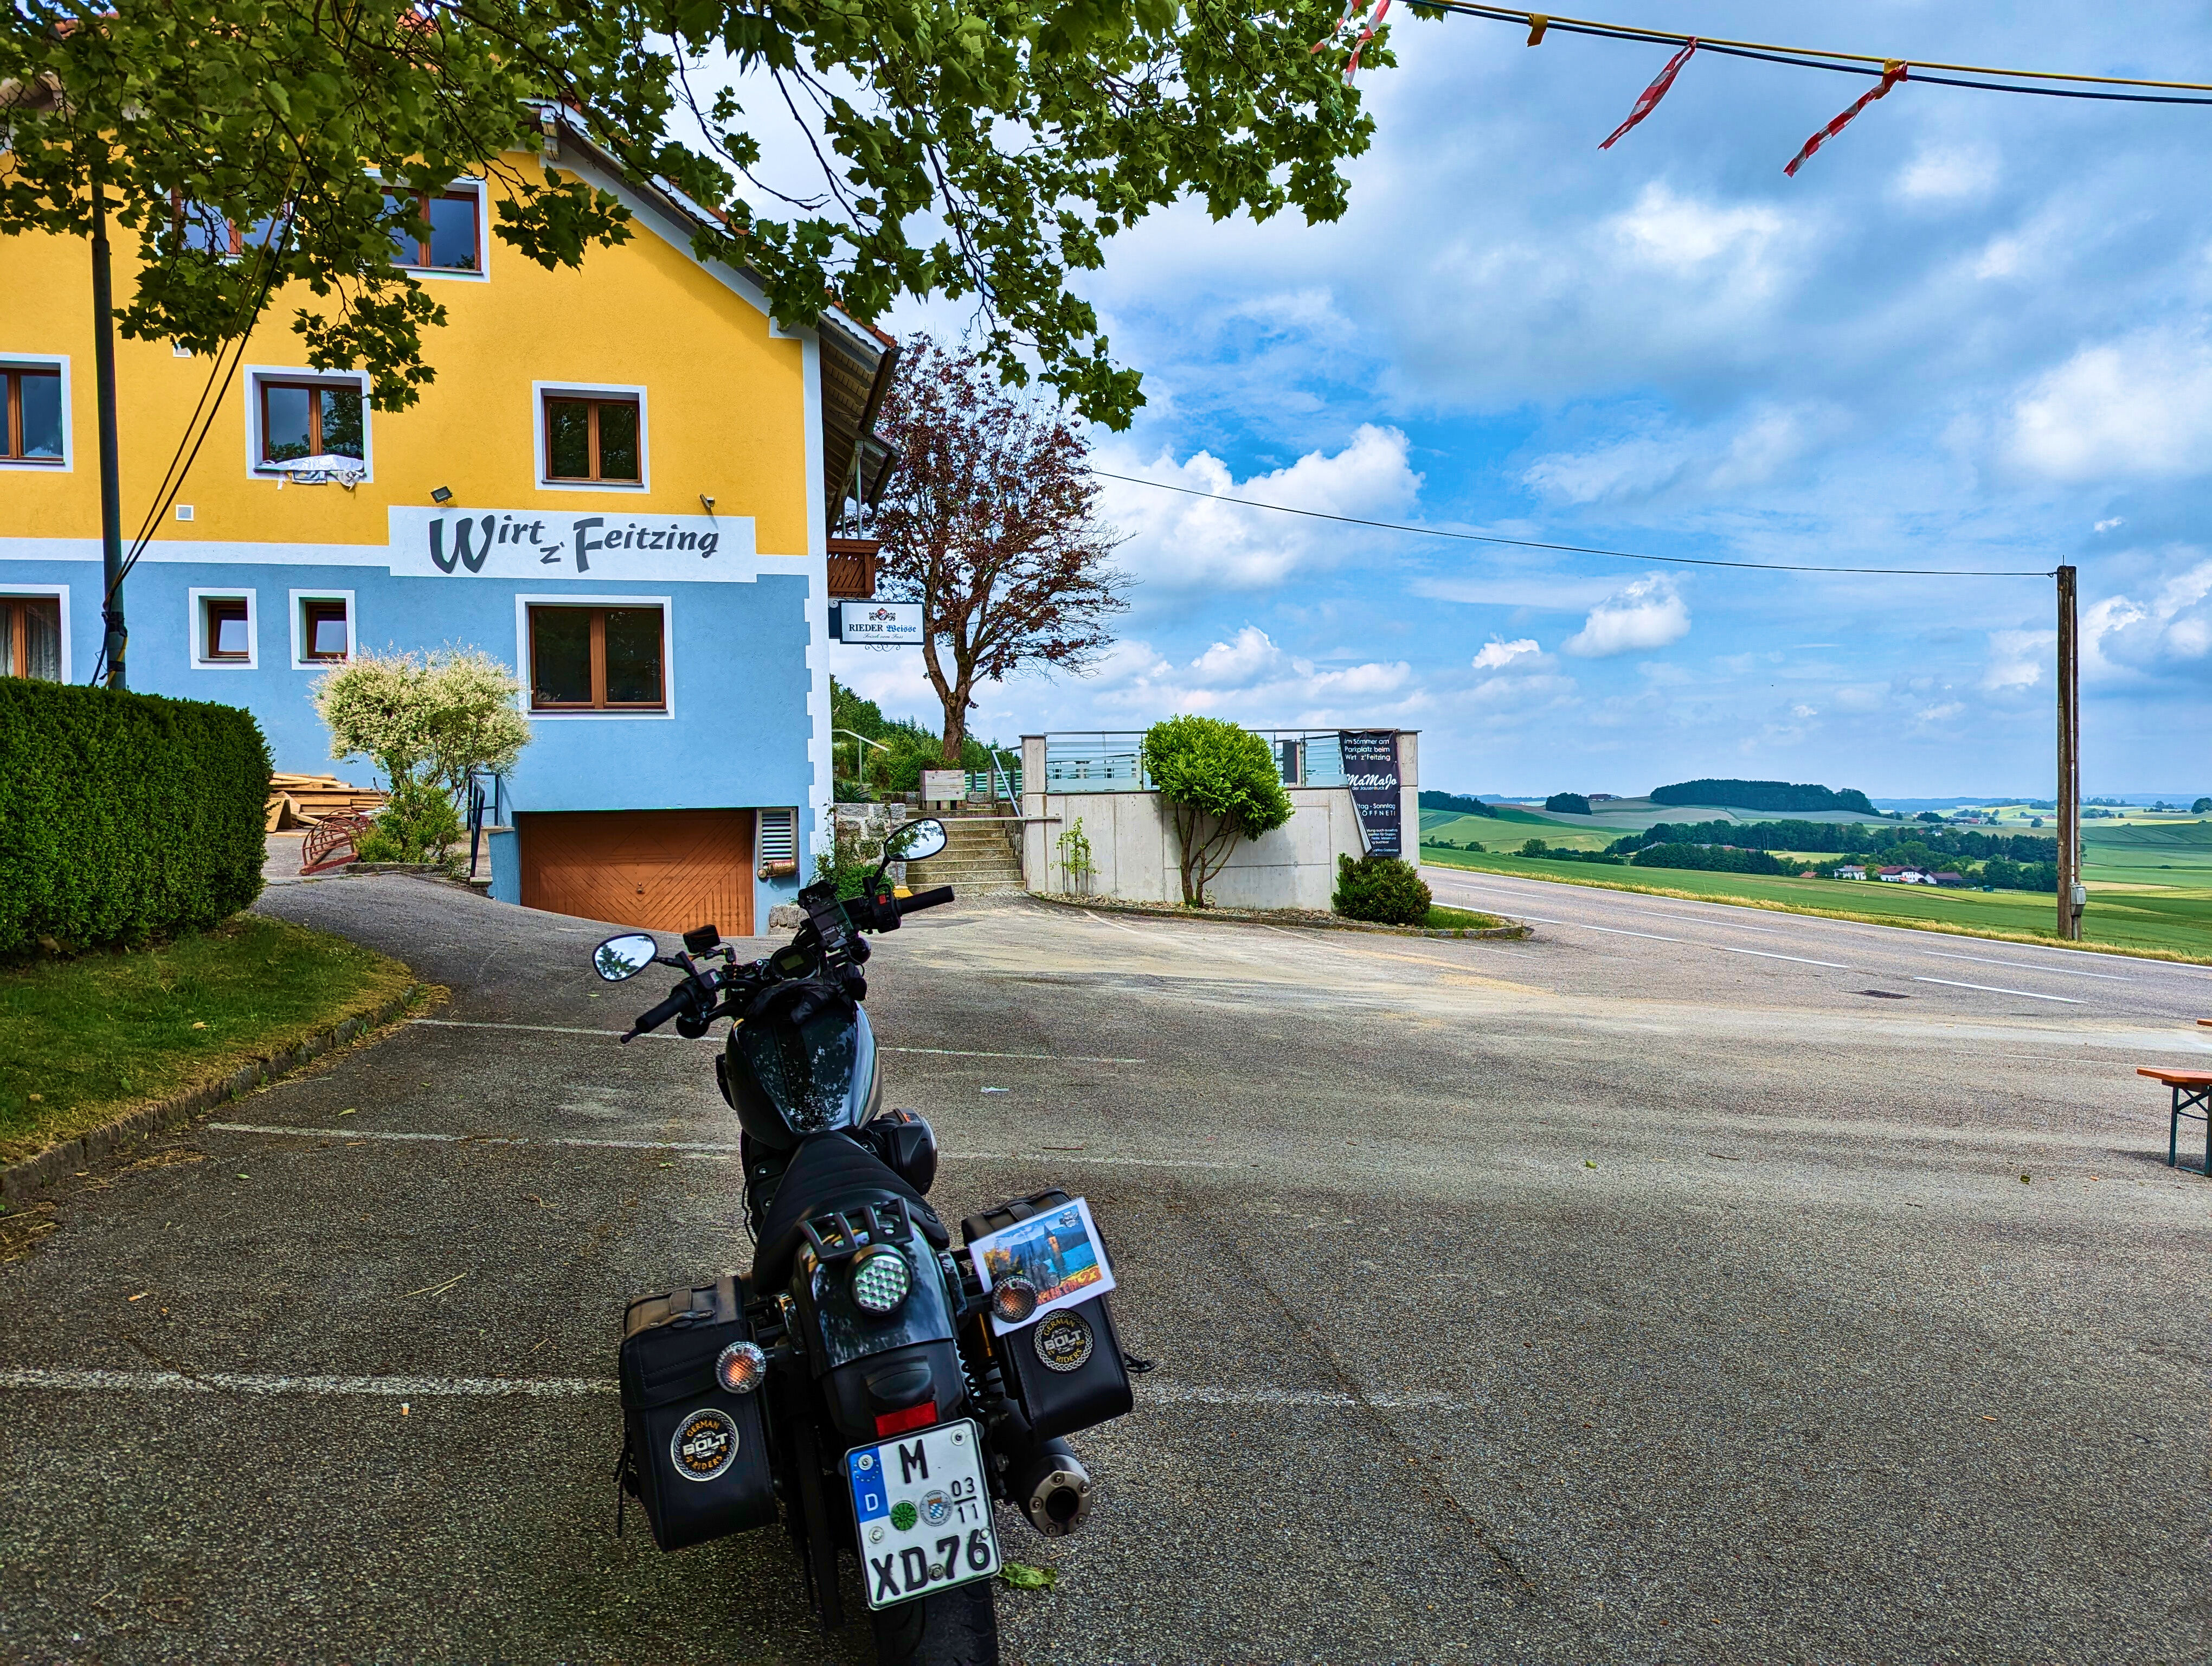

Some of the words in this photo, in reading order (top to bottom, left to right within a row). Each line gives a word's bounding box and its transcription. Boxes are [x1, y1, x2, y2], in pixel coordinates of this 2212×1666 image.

[429, 514, 544, 574] Wirt
[573, 517, 719, 573] Feitzing
[848, 624, 883, 632] RIEDER
[886, 624, 916, 632] Weisse
[1346, 774, 1397, 790] MaMaJo
[1044, 1318, 1075, 1336] GERMAN
[1044, 1330, 1081, 1350] BOLT
[1056, 1348, 1082, 1363] RIDERS
[686, 1420, 720, 1437] GERMAN
[683, 1433, 728, 1456] BOLT
[692, 1456, 722, 1470] RIDERS
[899, 1439, 929, 1484] M
[951, 1477, 975, 1497] 03
[865, 1493, 879, 1511] D
[958, 1503, 979, 1523] 11
